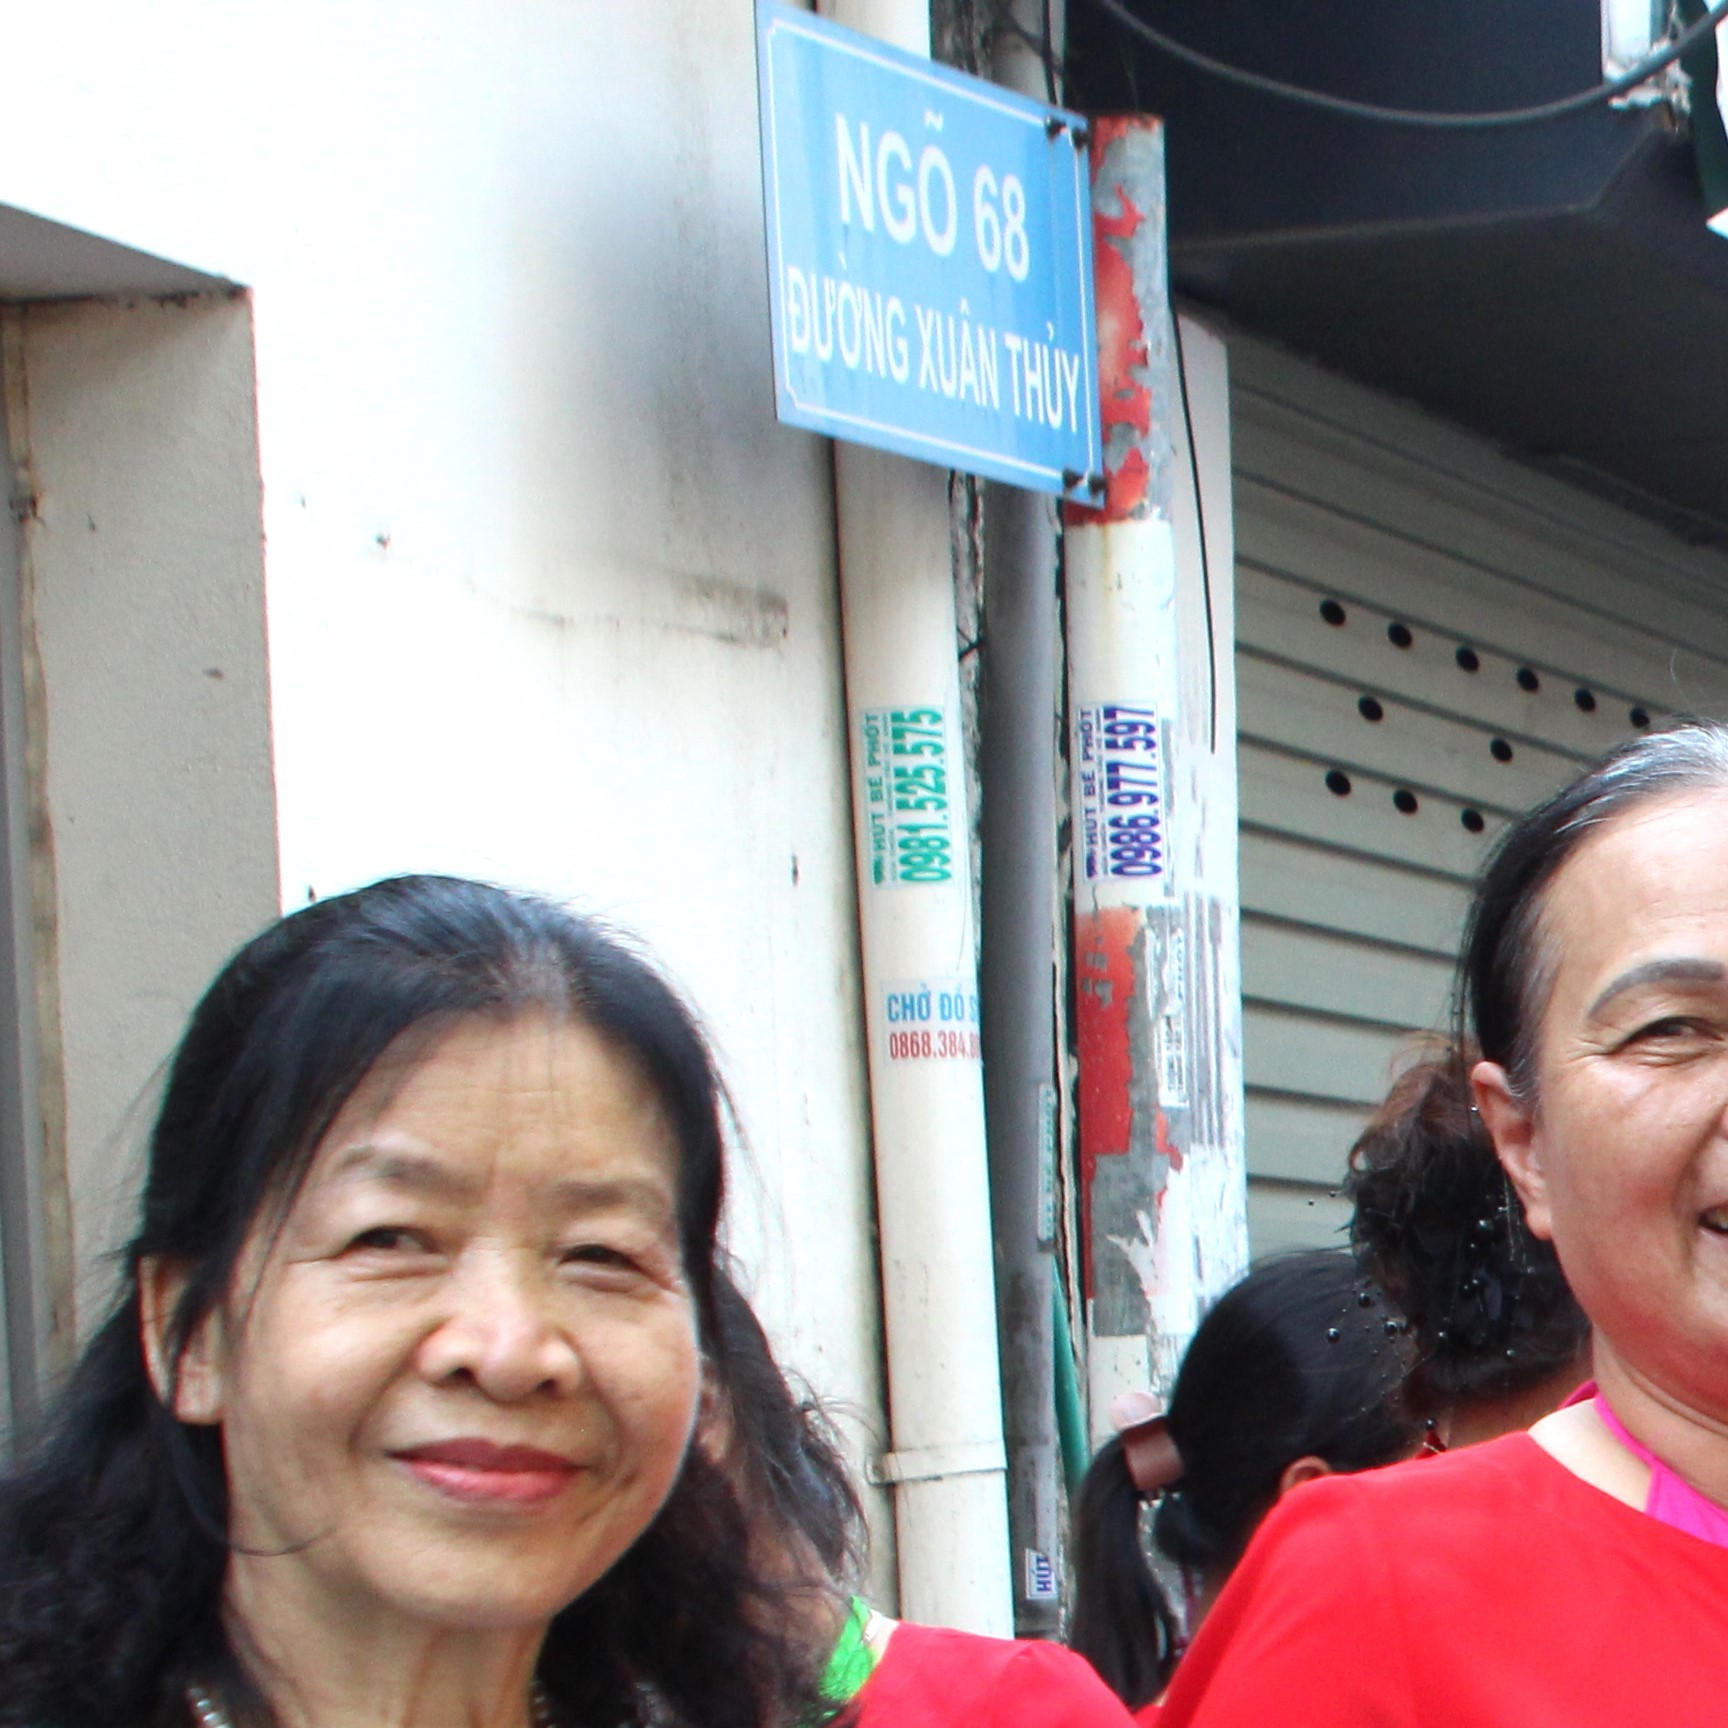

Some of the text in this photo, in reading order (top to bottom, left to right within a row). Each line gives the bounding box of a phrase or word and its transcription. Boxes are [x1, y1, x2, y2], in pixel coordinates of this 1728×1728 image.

[835, 109, 1030, 282] NGÕ 68
[786, 251, 1080, 435] ĐƯỜNG XUÂN THỦY
[890, 709, 952, 882] 0981.525.575
[1102, 705, 1163, 877] 0986.977.597
